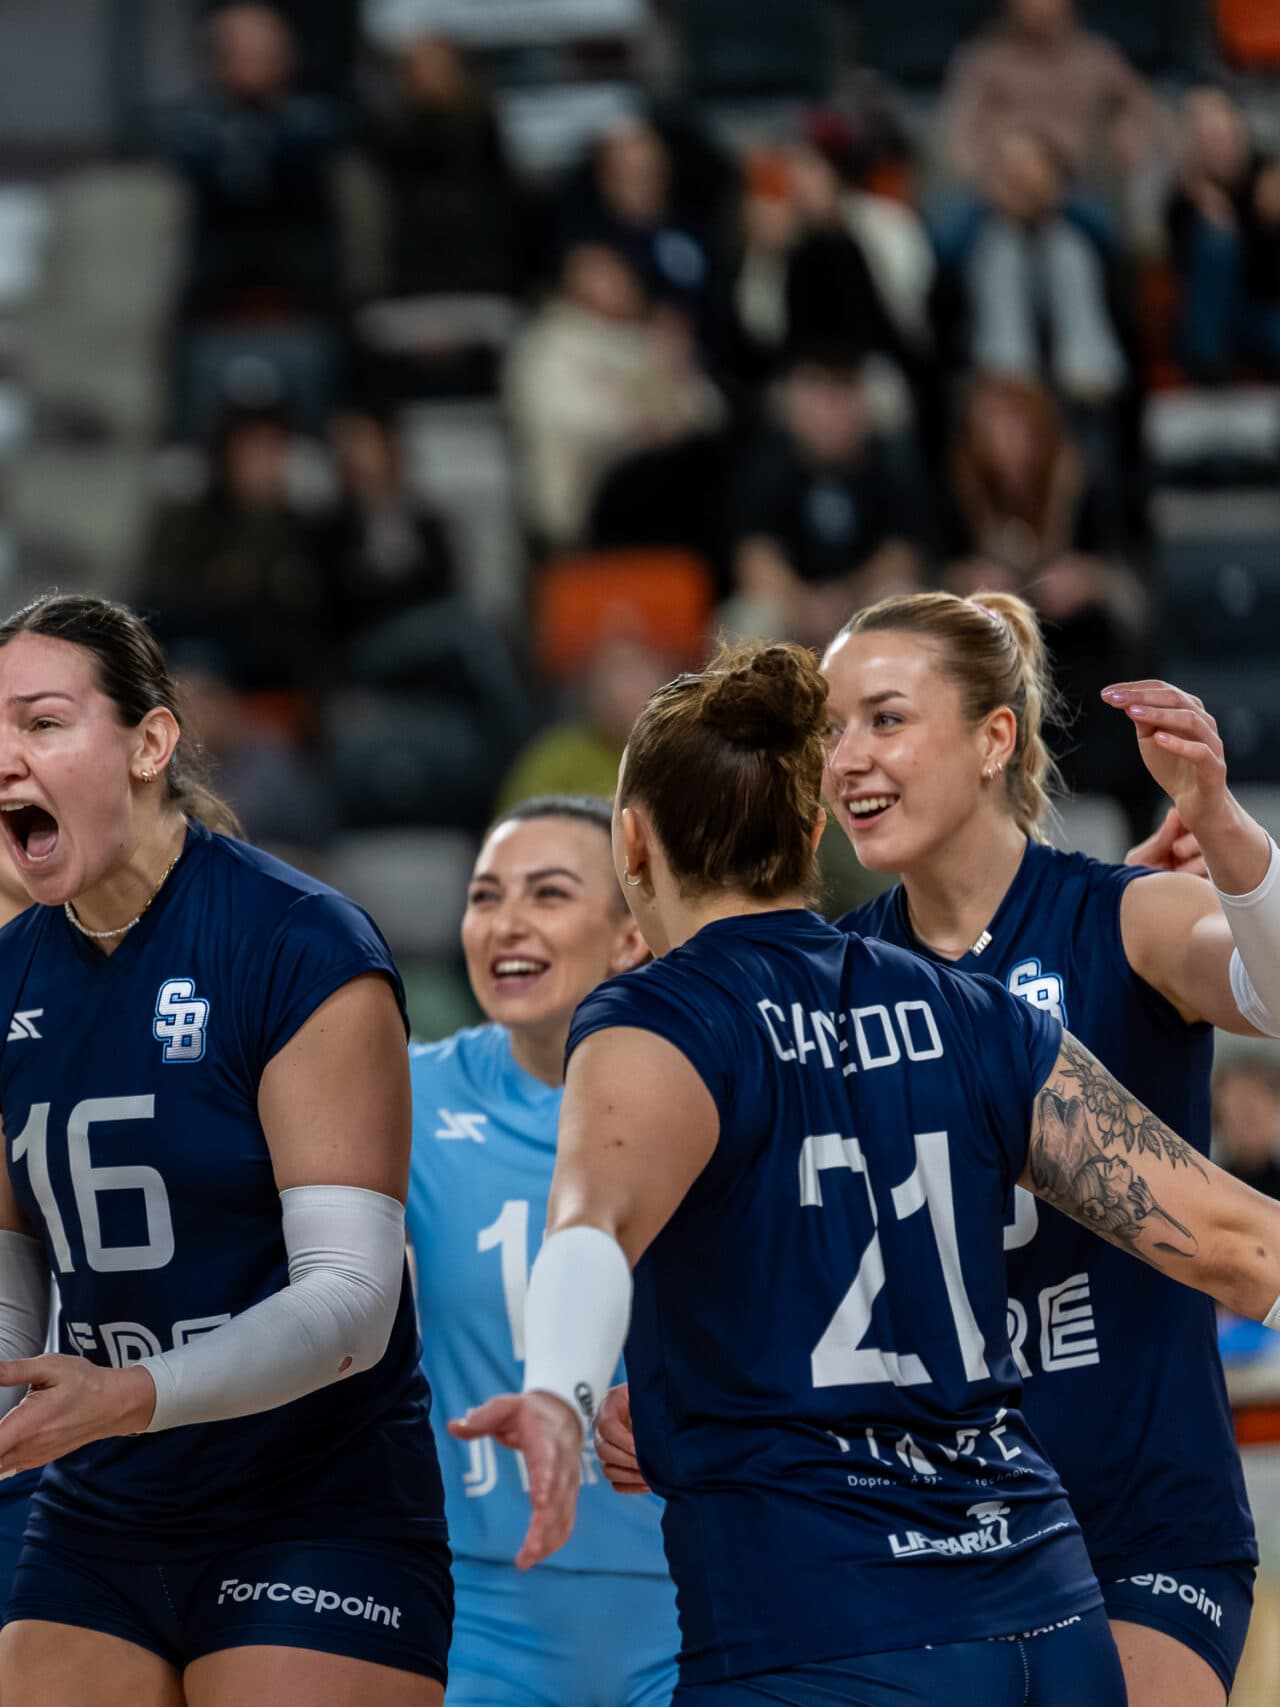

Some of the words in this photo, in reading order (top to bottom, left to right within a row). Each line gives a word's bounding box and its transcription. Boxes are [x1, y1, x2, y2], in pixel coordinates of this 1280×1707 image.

[153, 978, 210, 1063] SB
[12, 1094, 175, 1273] 16
[798, 1131, 990, 1388] 21
[217, 1578, 402, 1629] Forcepoint
[1115, 1573, 1223, 1627] epoint
